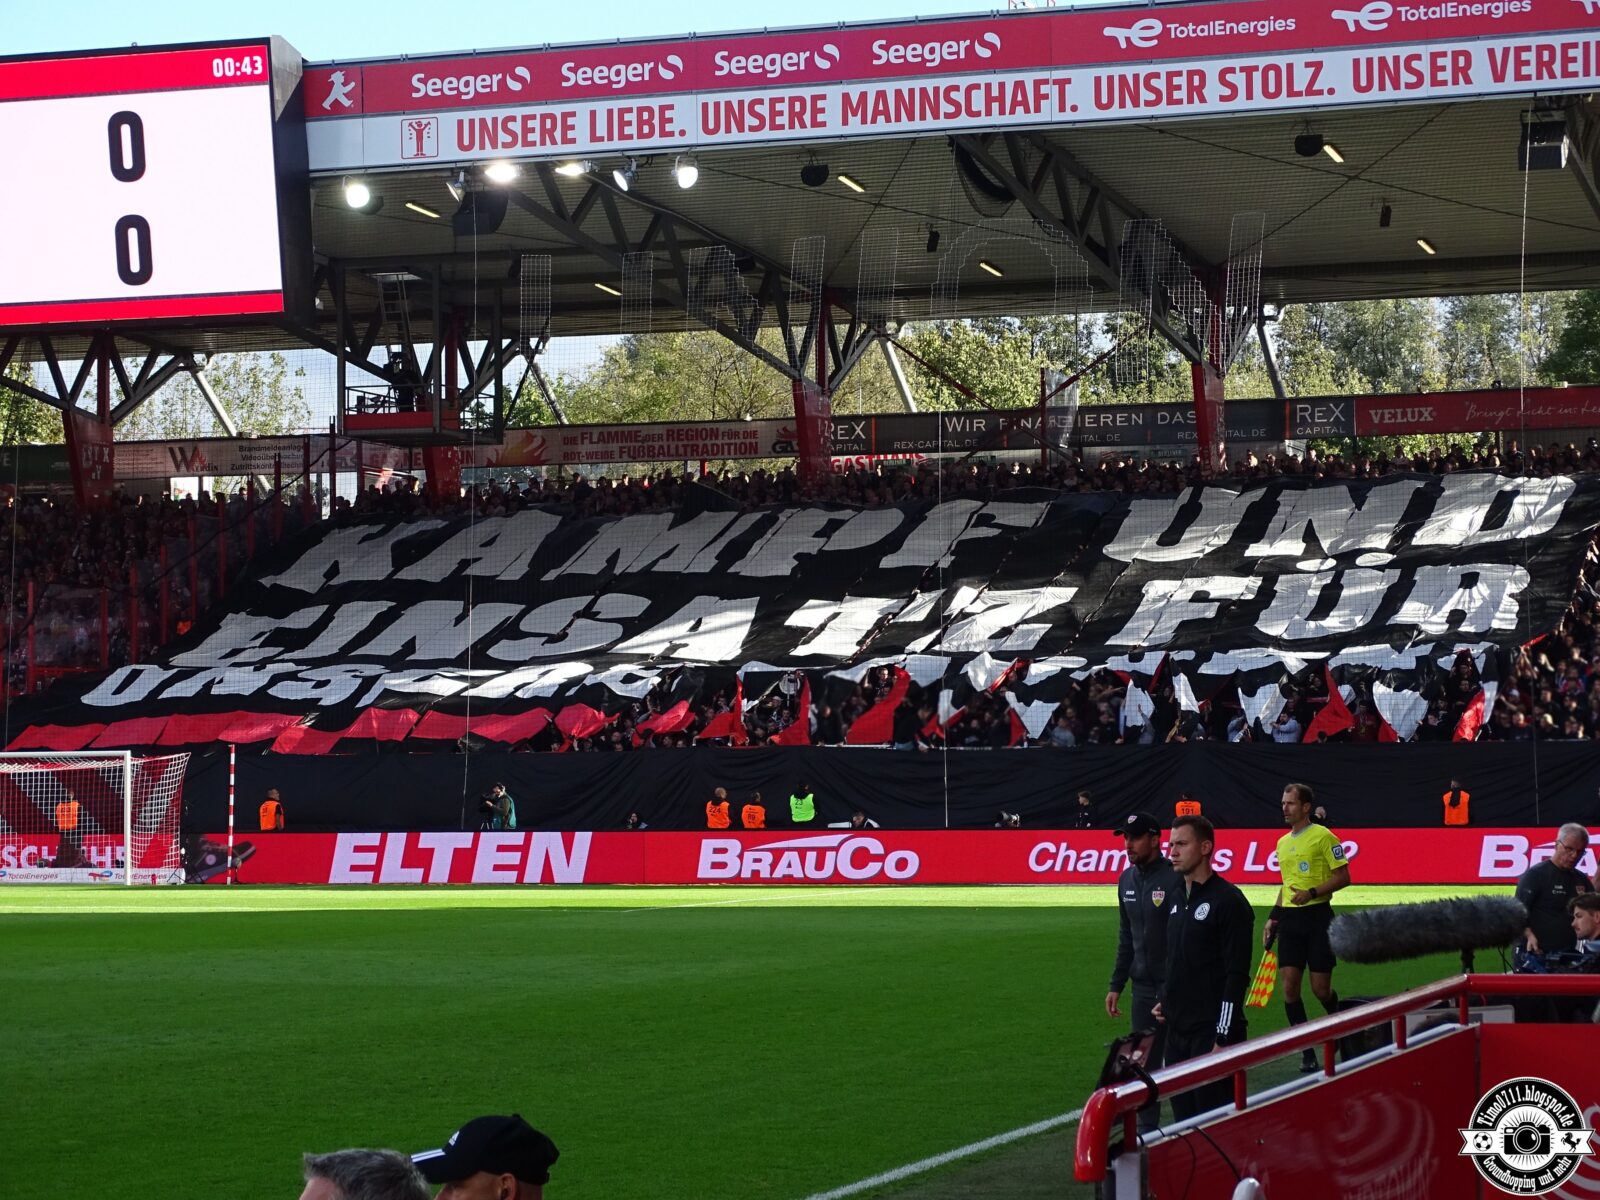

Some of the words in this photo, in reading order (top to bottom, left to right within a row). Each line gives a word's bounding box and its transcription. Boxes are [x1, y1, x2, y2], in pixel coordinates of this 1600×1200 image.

[1397, 0, 1532, 21] TotalEnergies
[1167, 16, 1296, 39] TotalEnergies
[212, 56, 262, 77] 00:43
[714, 48, 809, 78] Seeger
[872, 38, 970, 67] Seeger
[411, 72, 502, 100] Seeger
[561, 61, 654, 89] Seeger
[457, 111, 577, 152] UNSERE
[589, 104, 687, 143] LIEBE.
[701, 94, 827, 136] UNSERE
[841, 78, 1079, 126] MANNSCHAFT.
[1094, 69, 1207, 111] UNSER
[1218, 60, 1336, 102] STOLZ.
[1352, 49, 1473, 93] UNSER
[107, 110, 146, 182] 0
[115, 214, 153, 286] 0
[1157, 411, 1197, 425] DAS
[1369, 407, 1433, 424] VELUX
[563, 436, 578, 446] DIE
[580, 430, 643, 445] FLAMME
[666, 427, 719, 442] REGION
[721, 430, 740, 441] FÜR
[743, 430, 759, 440] DIE
[1297, 426, 1345, 435] CAPITAL
[830, 443, 866, 452] APITAL
[259, 500, 1052, 594] KAMPF
[1102, 474, 1575, 564] UND
[169, 586, 1077, 668] EINSATZ
[1105, 551, 1531, 648] FÜR
[327, 831, 593, 884] ELTEN
[8, 872, 58, 881] TotalEnergies
